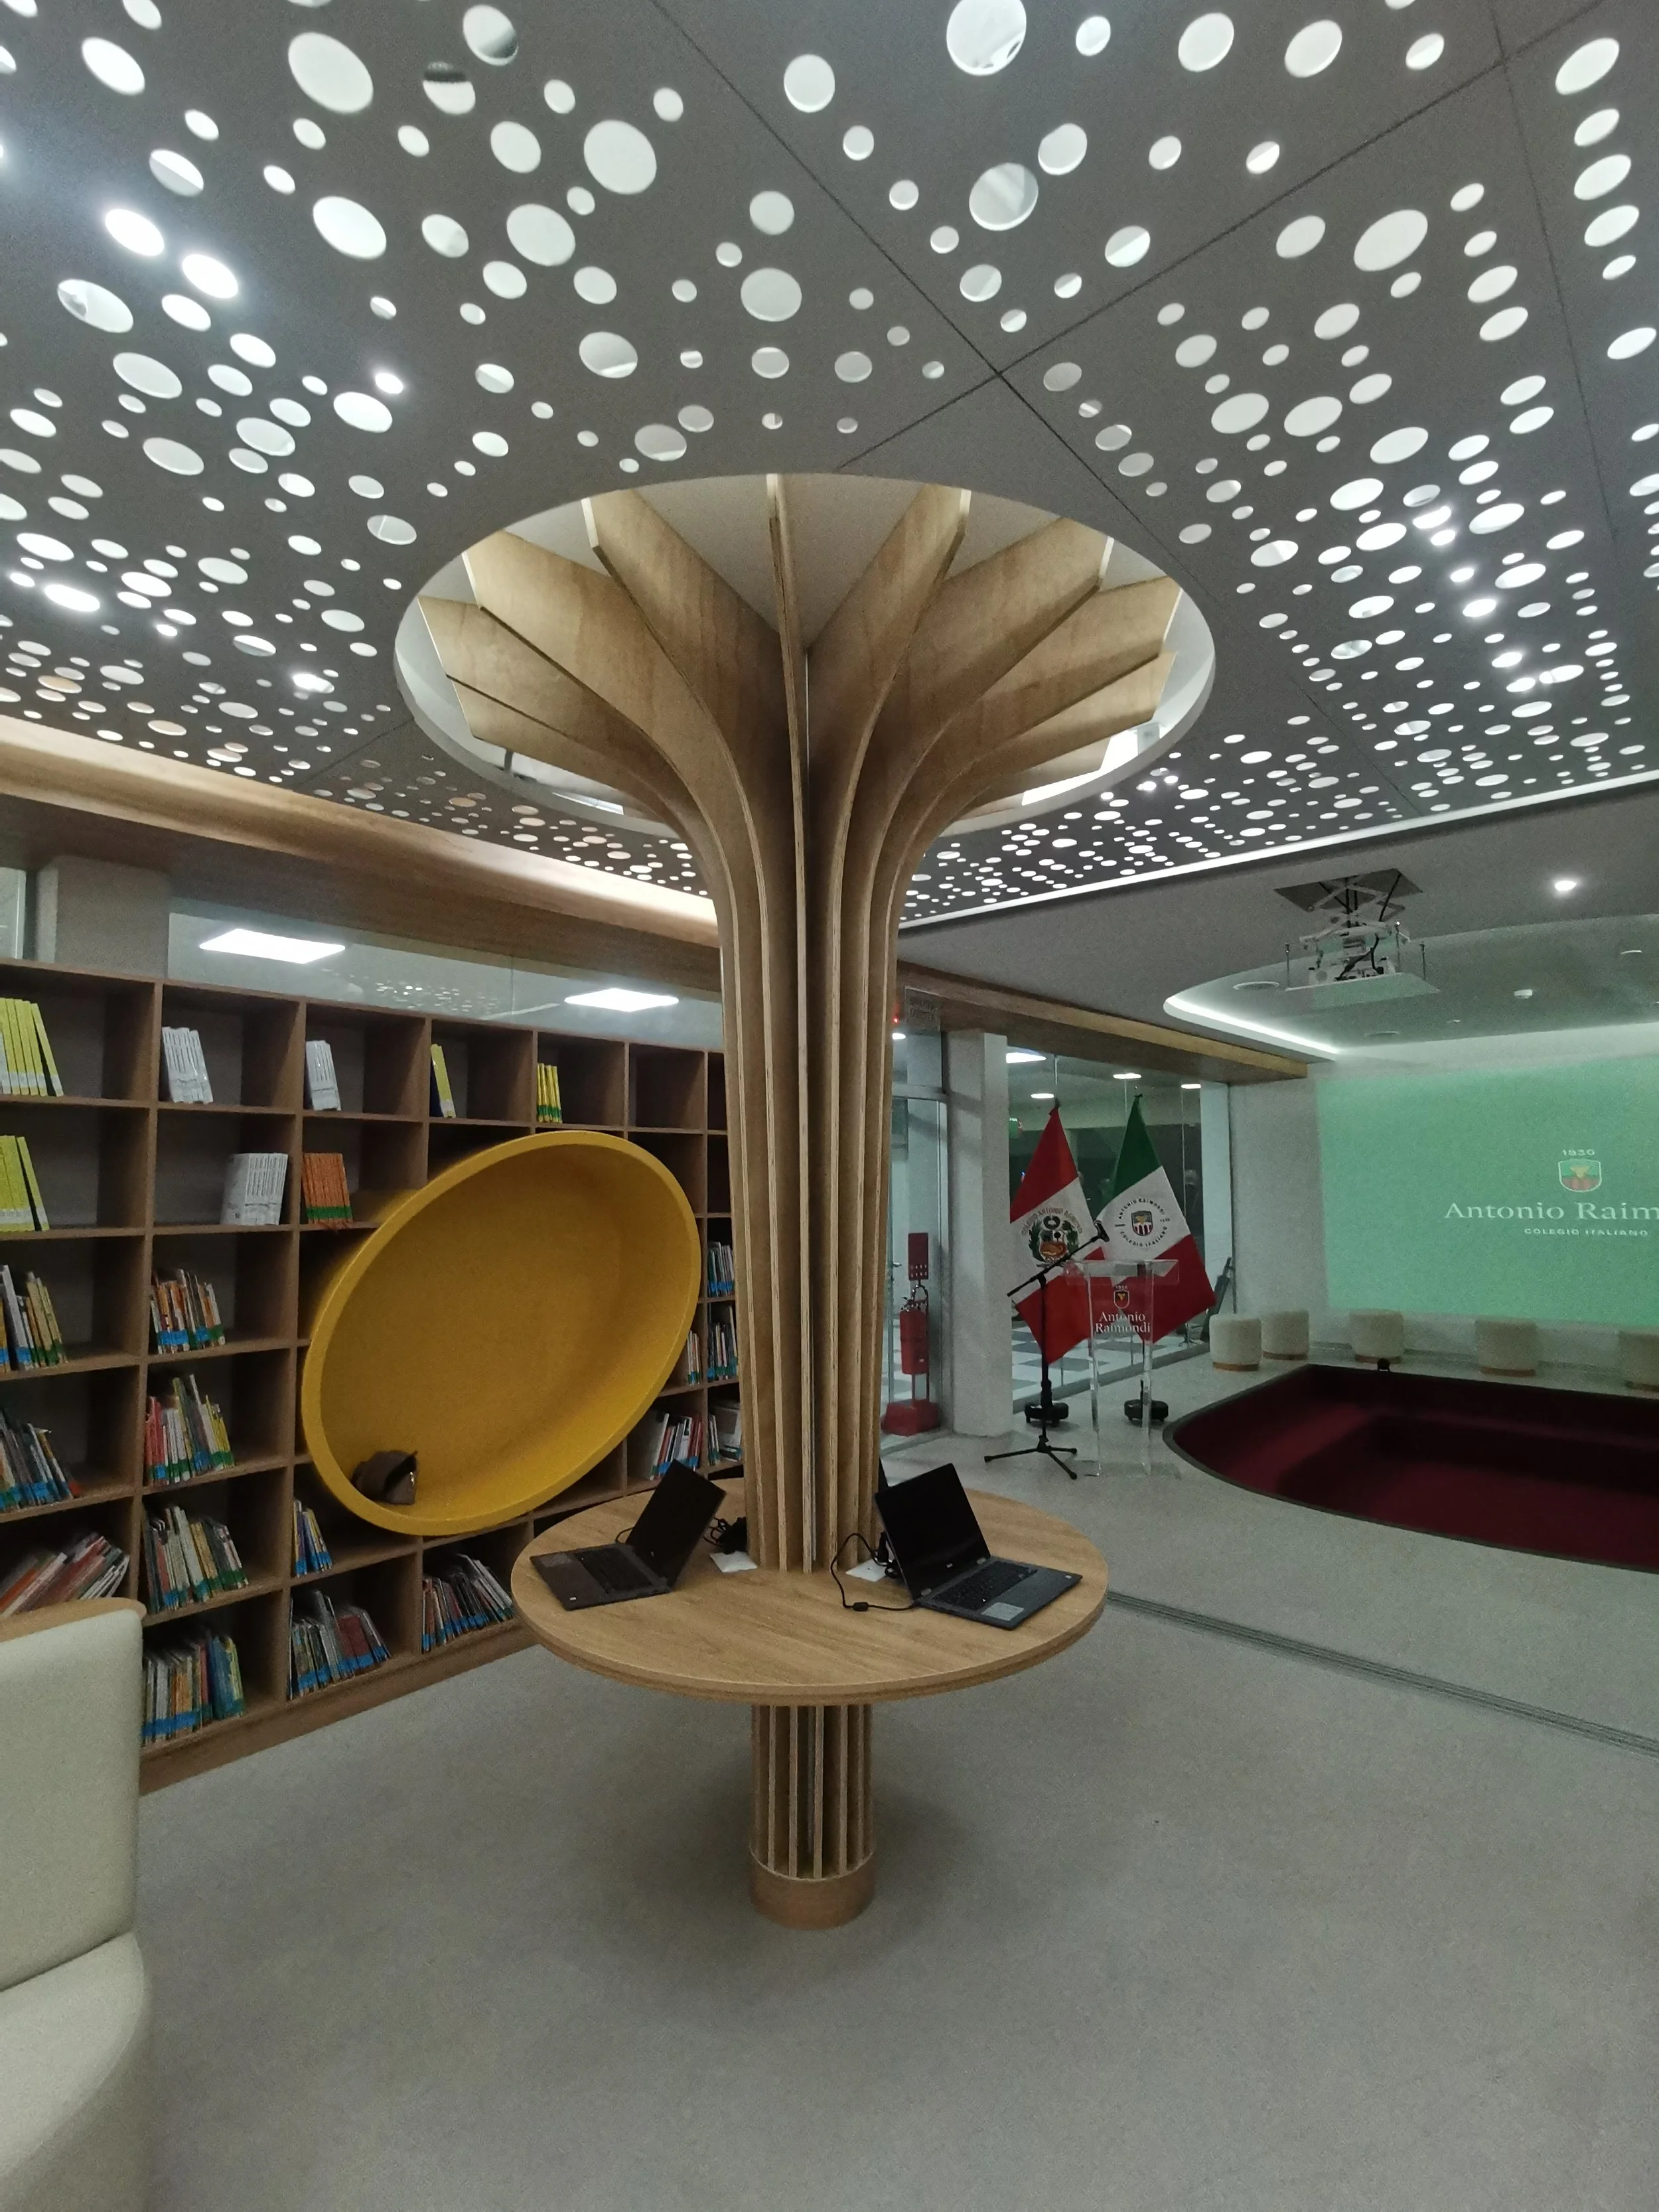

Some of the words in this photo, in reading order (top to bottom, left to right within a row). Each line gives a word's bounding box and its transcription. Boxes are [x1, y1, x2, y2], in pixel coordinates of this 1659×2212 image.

[1444, 1202, 1565, 1219] Antonio
[1574, 1202, 1659, 1220] Raim
[1099, 1311, 1145, 1322] Antonio
[1096, 1321, 1151, 1333] Raimondi
